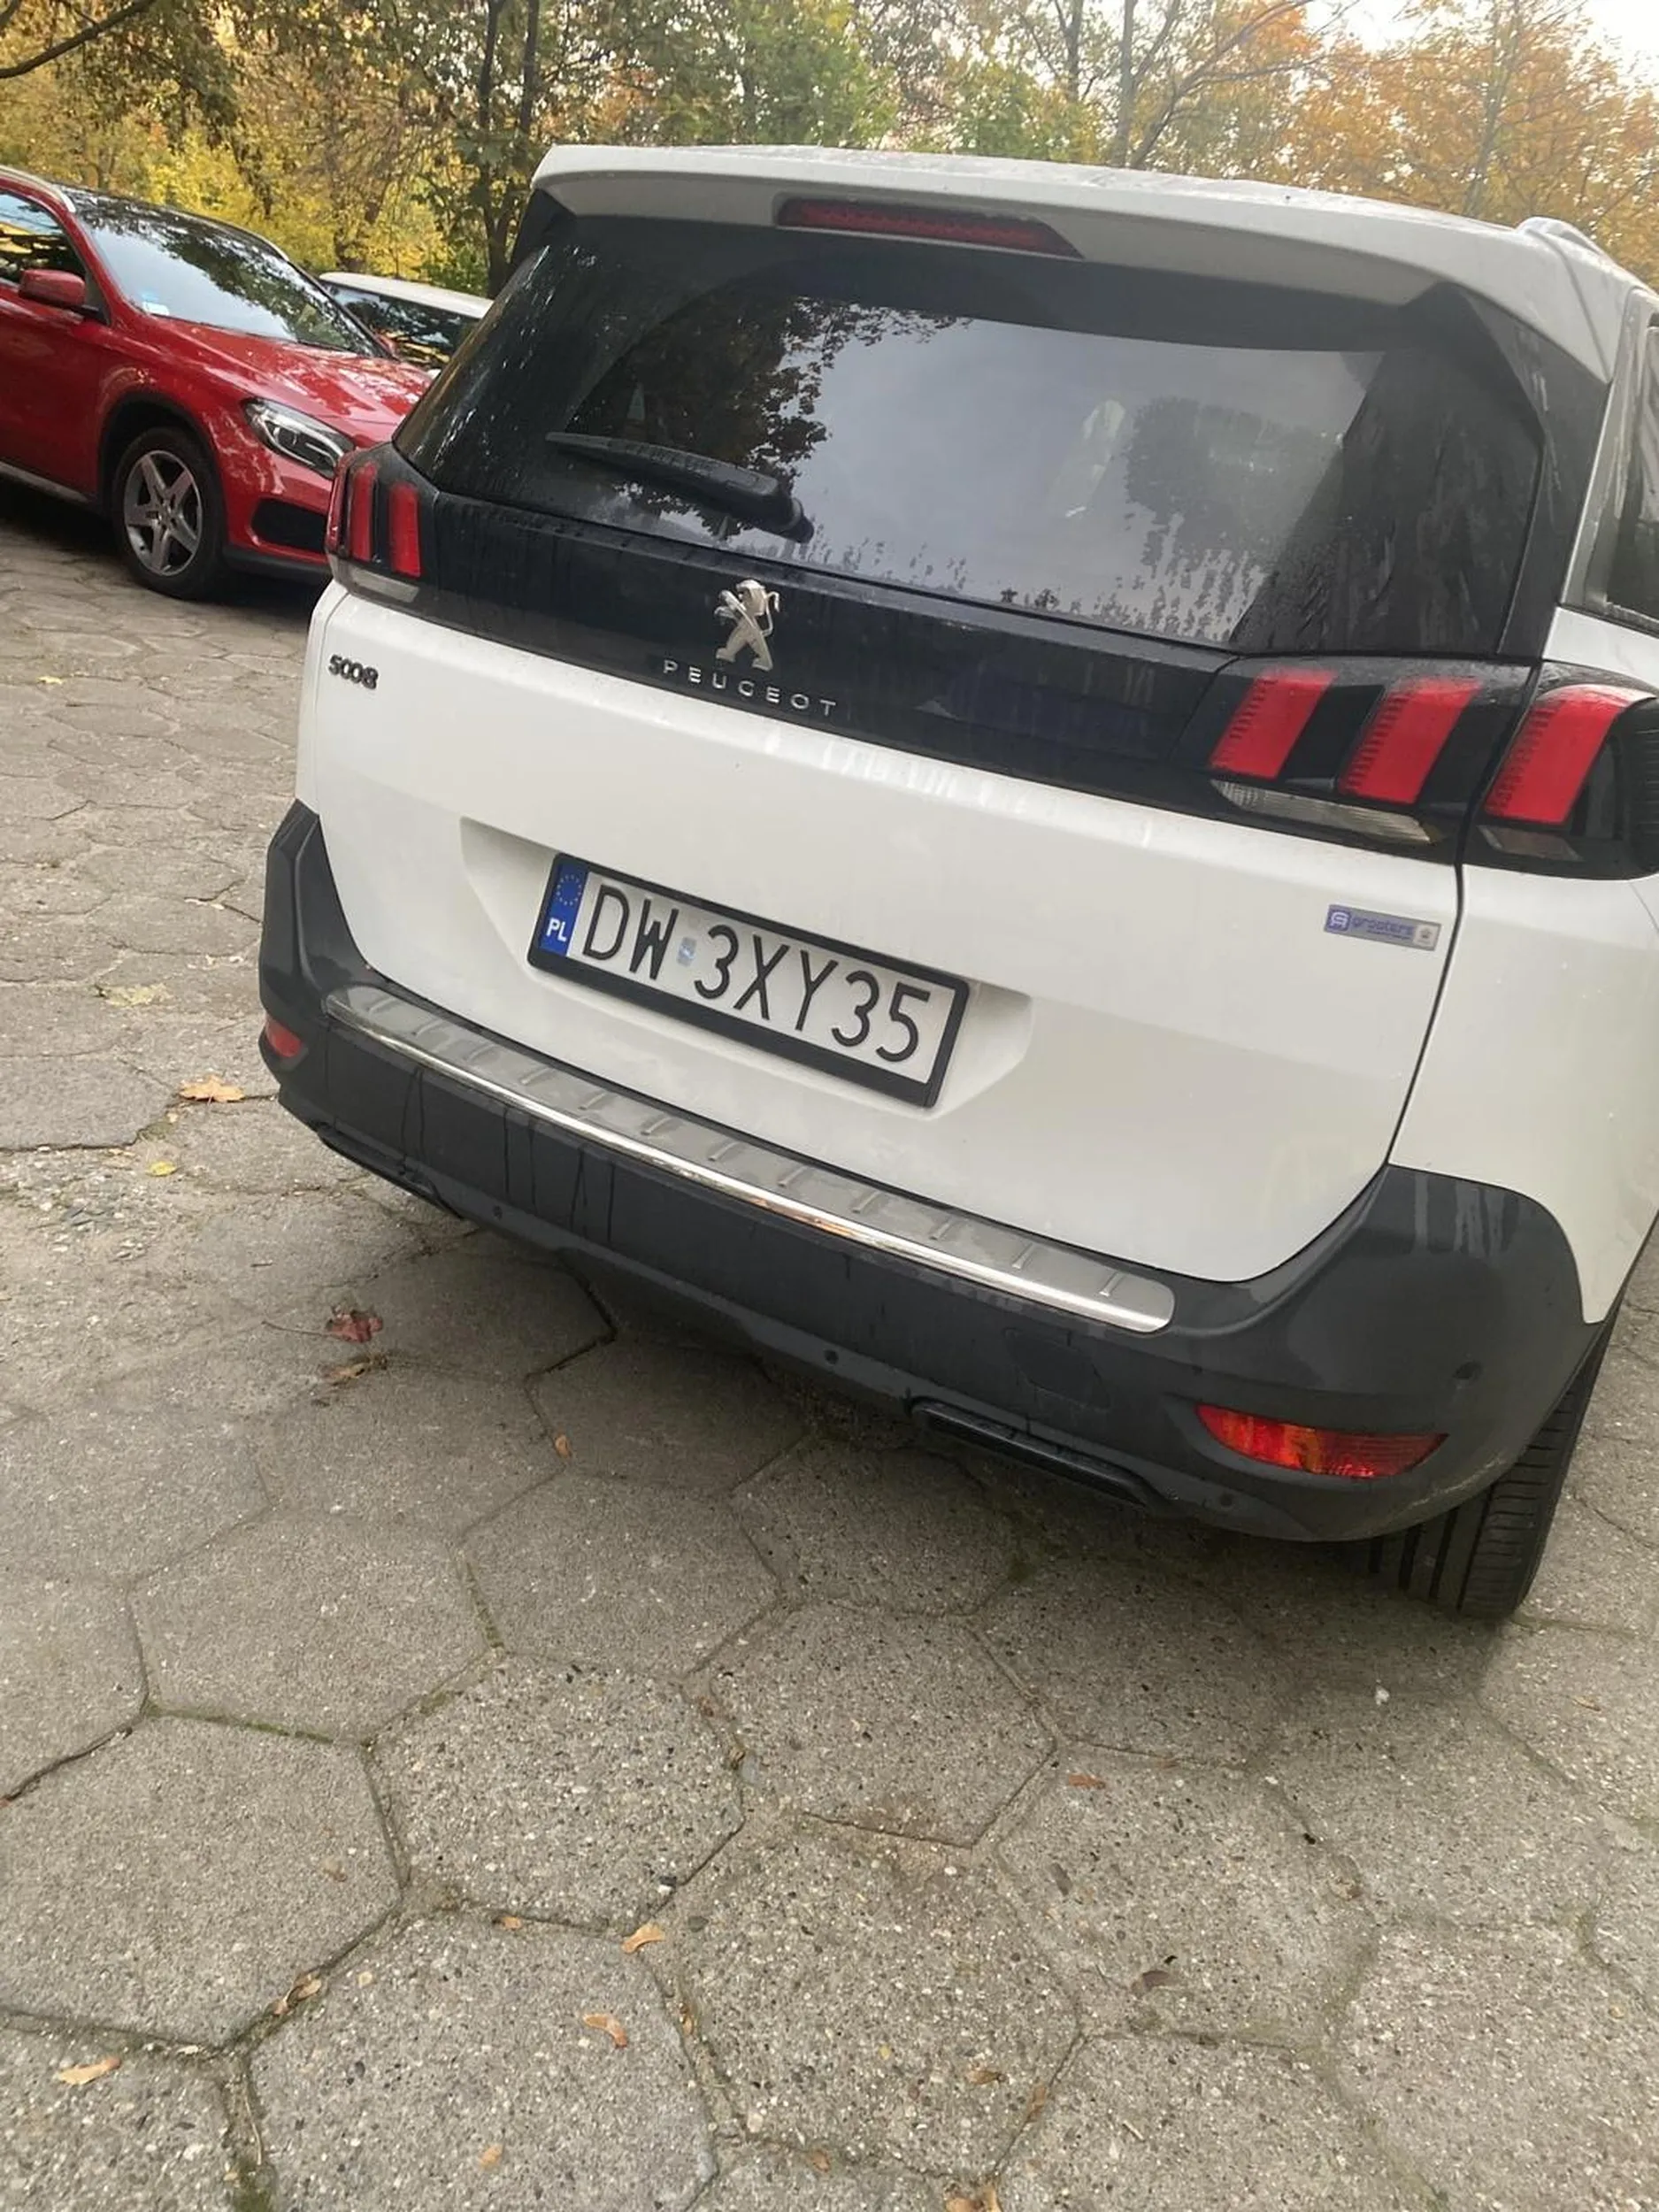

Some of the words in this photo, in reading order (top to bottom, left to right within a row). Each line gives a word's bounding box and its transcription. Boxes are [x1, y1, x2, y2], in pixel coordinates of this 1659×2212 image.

[328, 654, 379, 689] 5008
[663, 659, 836, 717] PEUGEOT
[546, 918, 568, 941] PL
[582, 884, 679, 980] DW
[694, 924, 931, 1063] 3XY35
